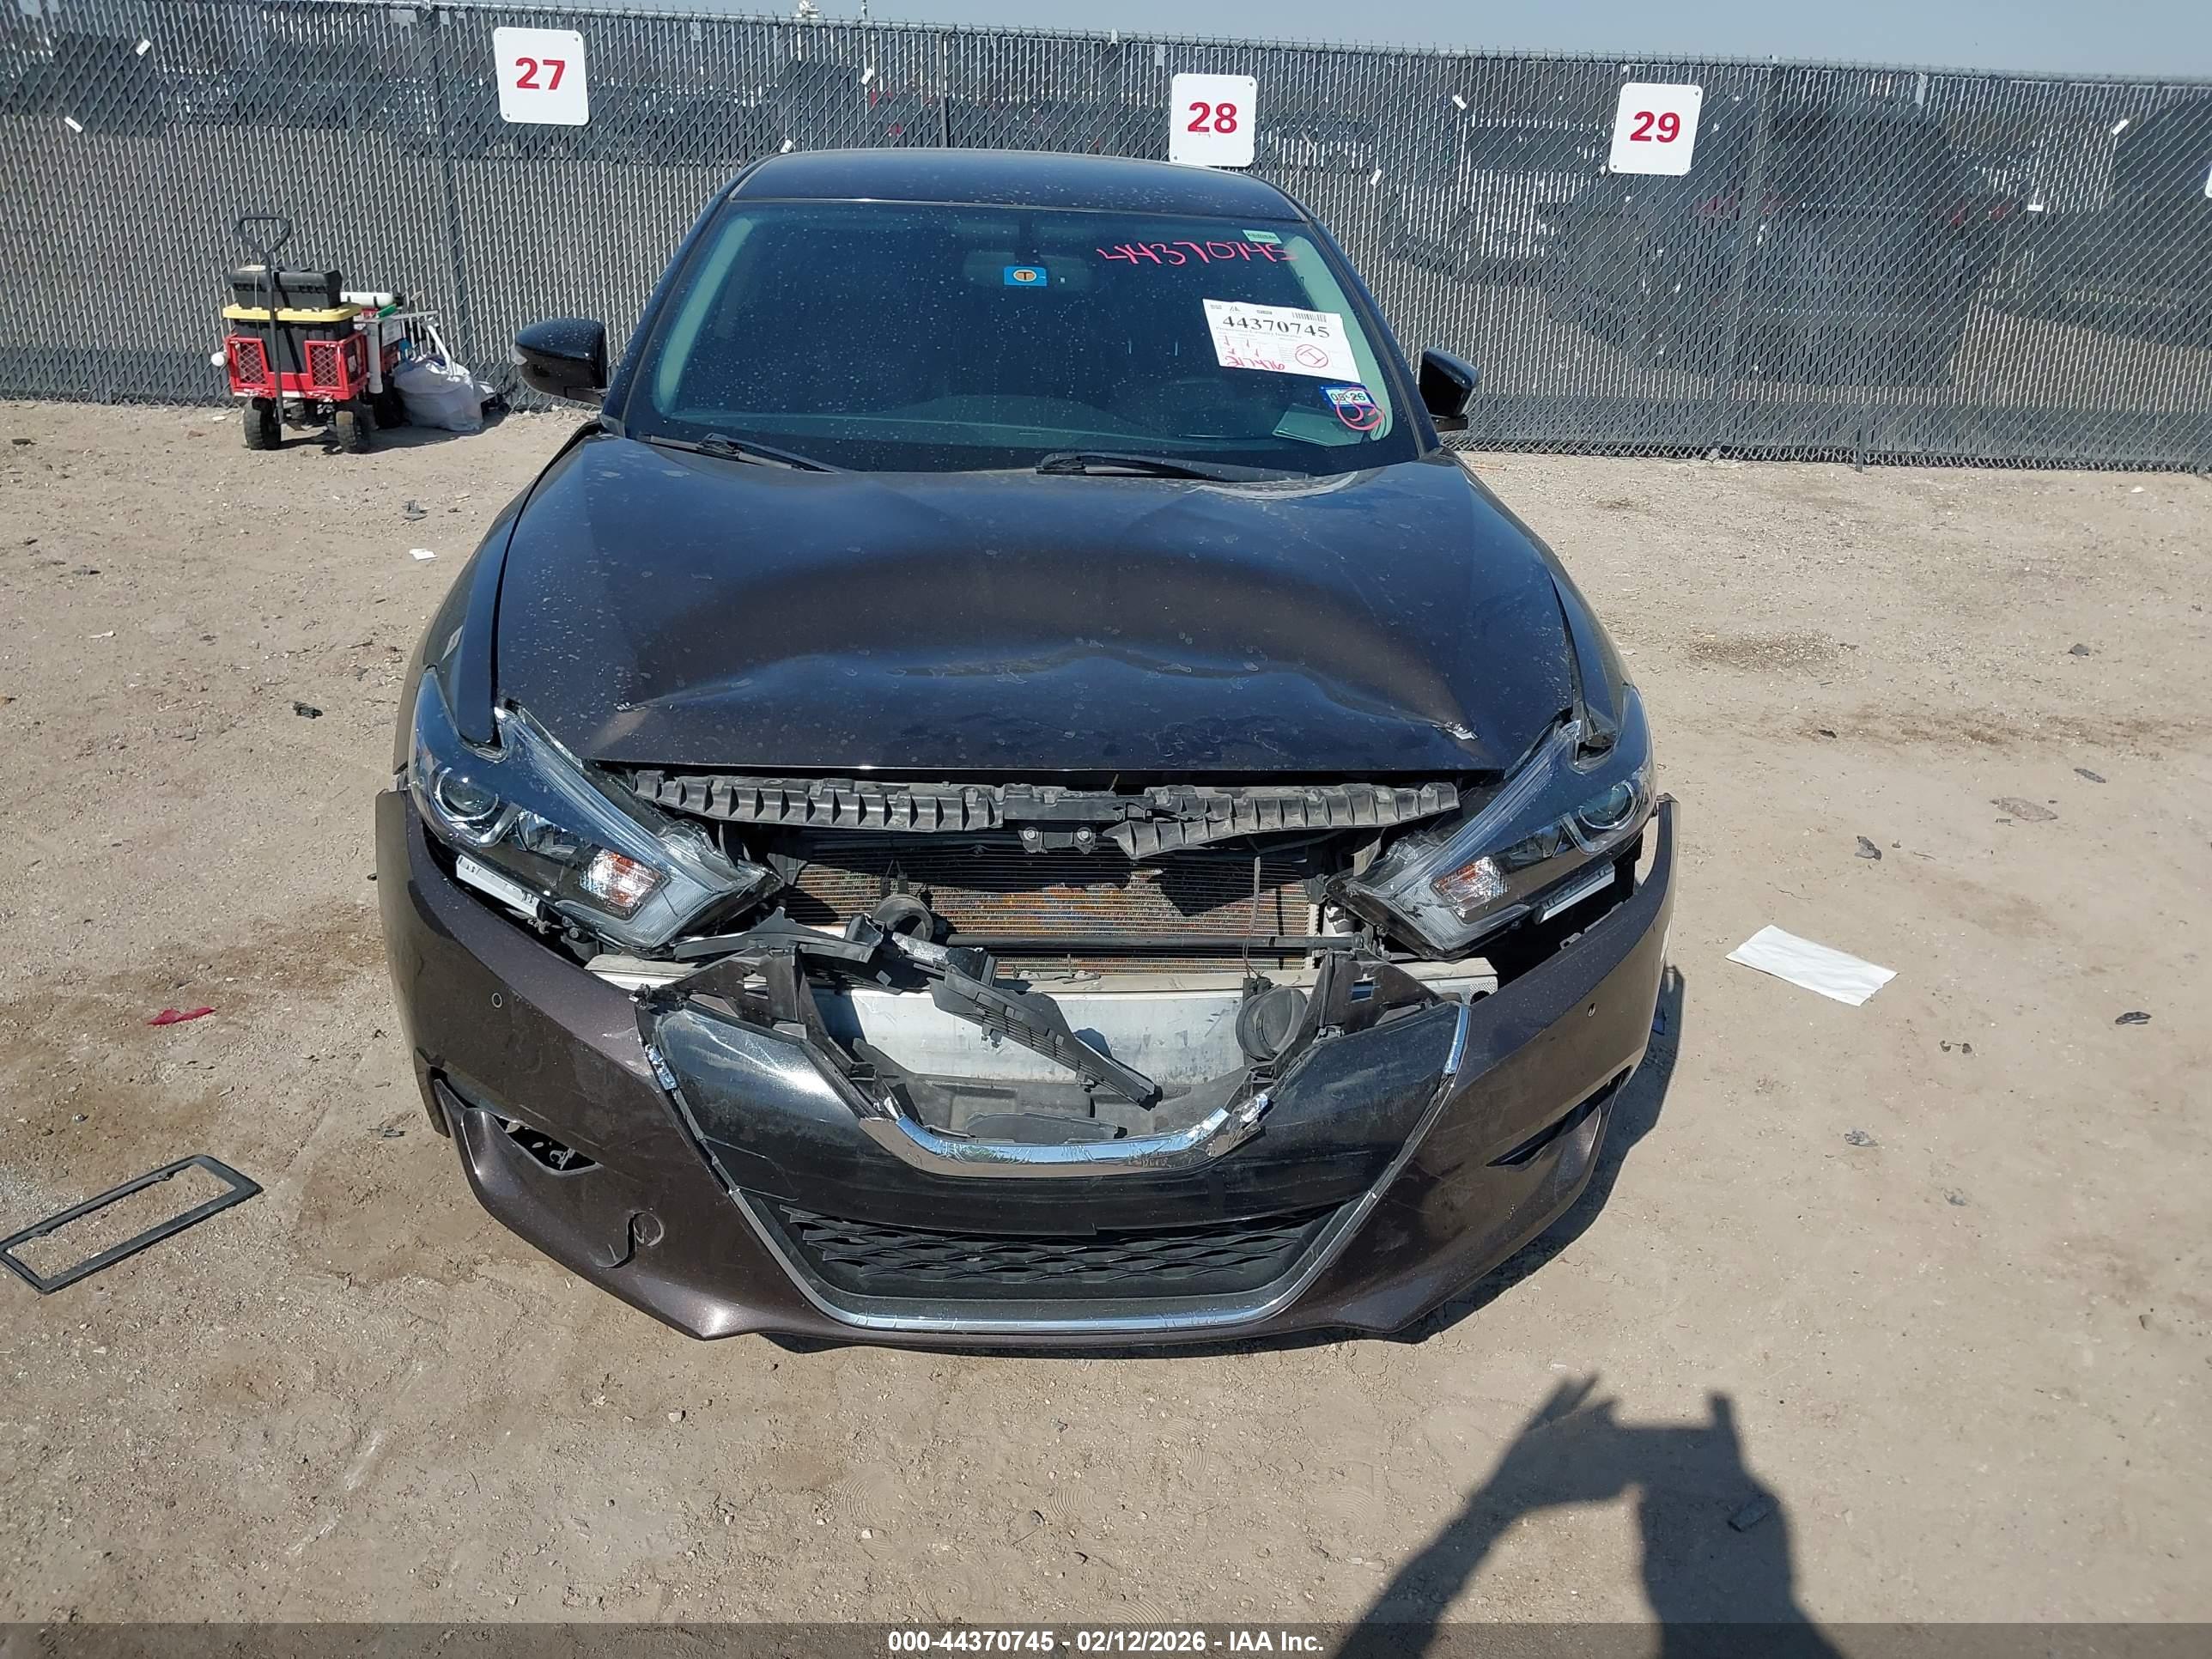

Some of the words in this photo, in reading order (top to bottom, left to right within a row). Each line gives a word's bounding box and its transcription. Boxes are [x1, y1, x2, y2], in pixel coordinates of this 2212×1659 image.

[515, 58, 565, 90] 27
[1188, 101, 1237, 133] 28
[1630, 111, 1680, 143] 29
[1096, 241, 1298, 264] 44370745
[1222, 315, 1330, 338] 44370745
